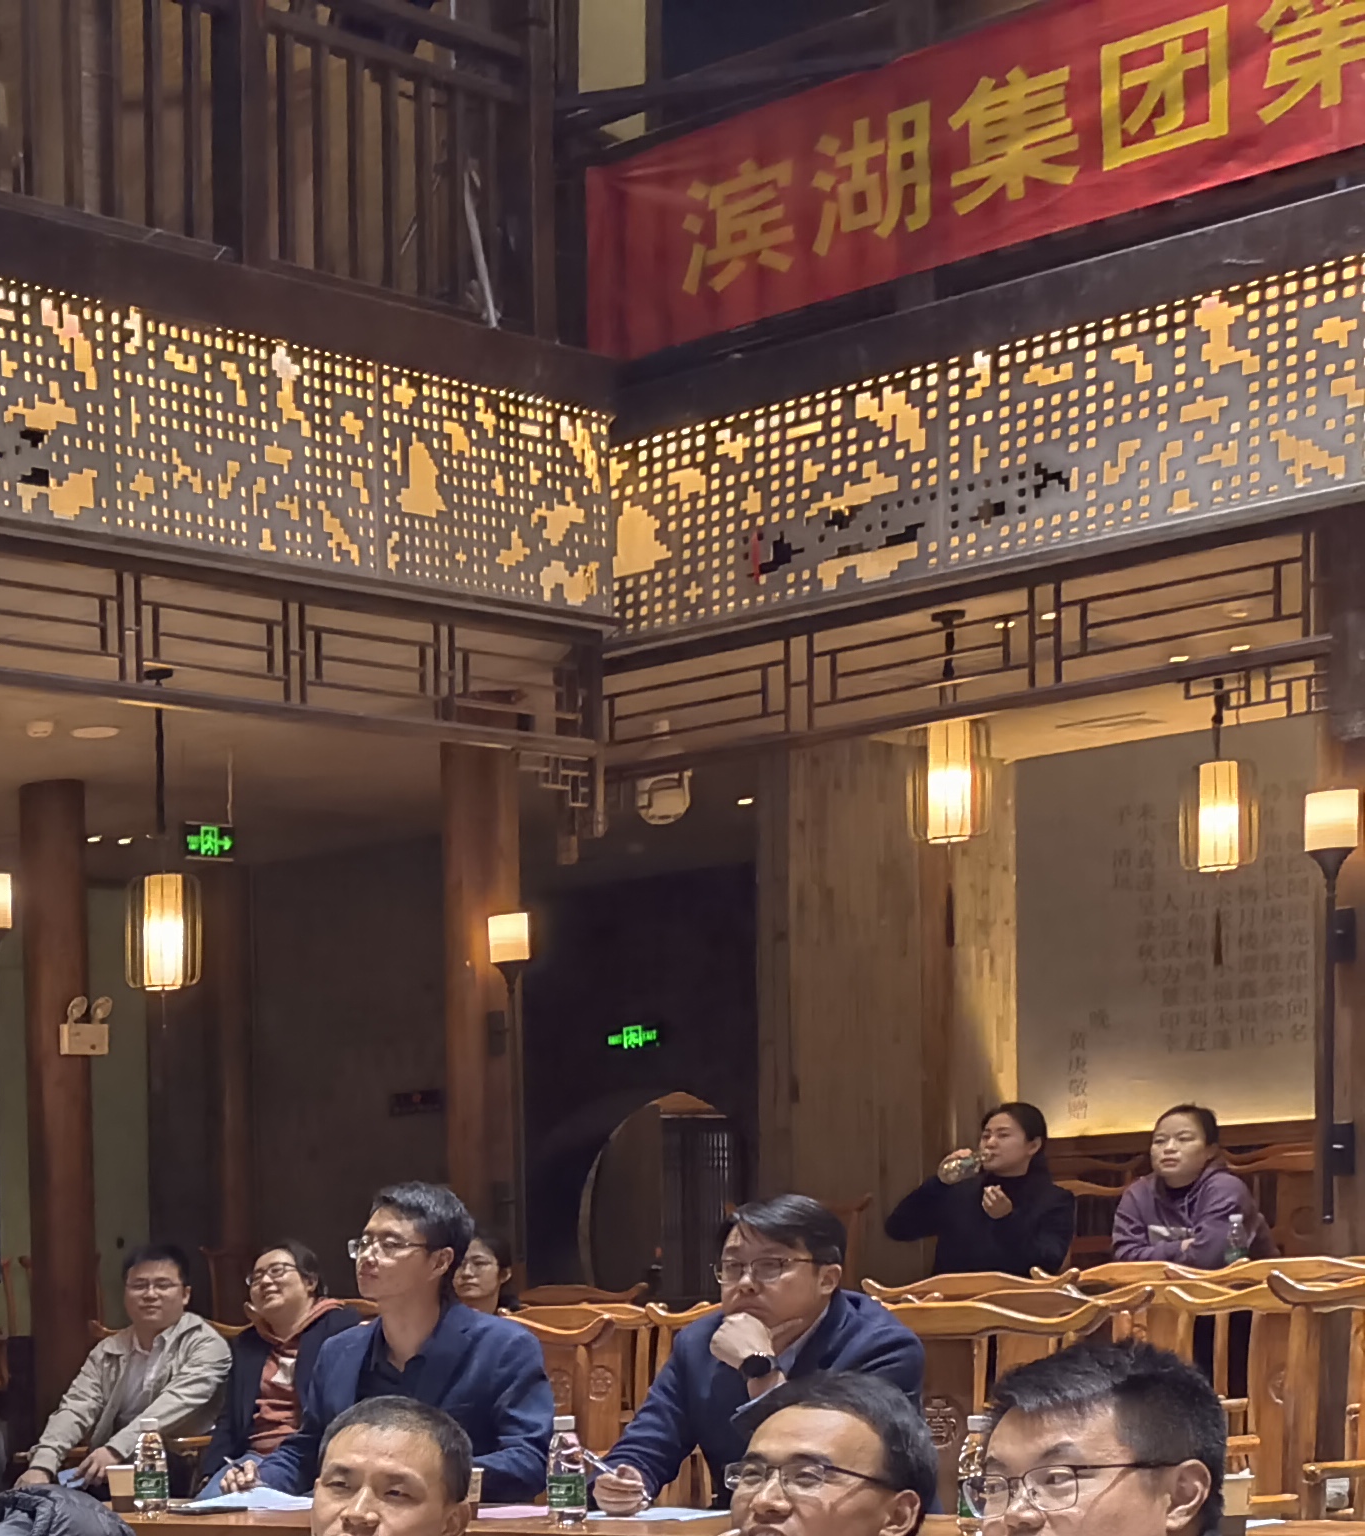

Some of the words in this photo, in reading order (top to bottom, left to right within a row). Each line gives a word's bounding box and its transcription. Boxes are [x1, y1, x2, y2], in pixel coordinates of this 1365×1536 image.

[680, 0, 1365, 296] 滨湖集团第
